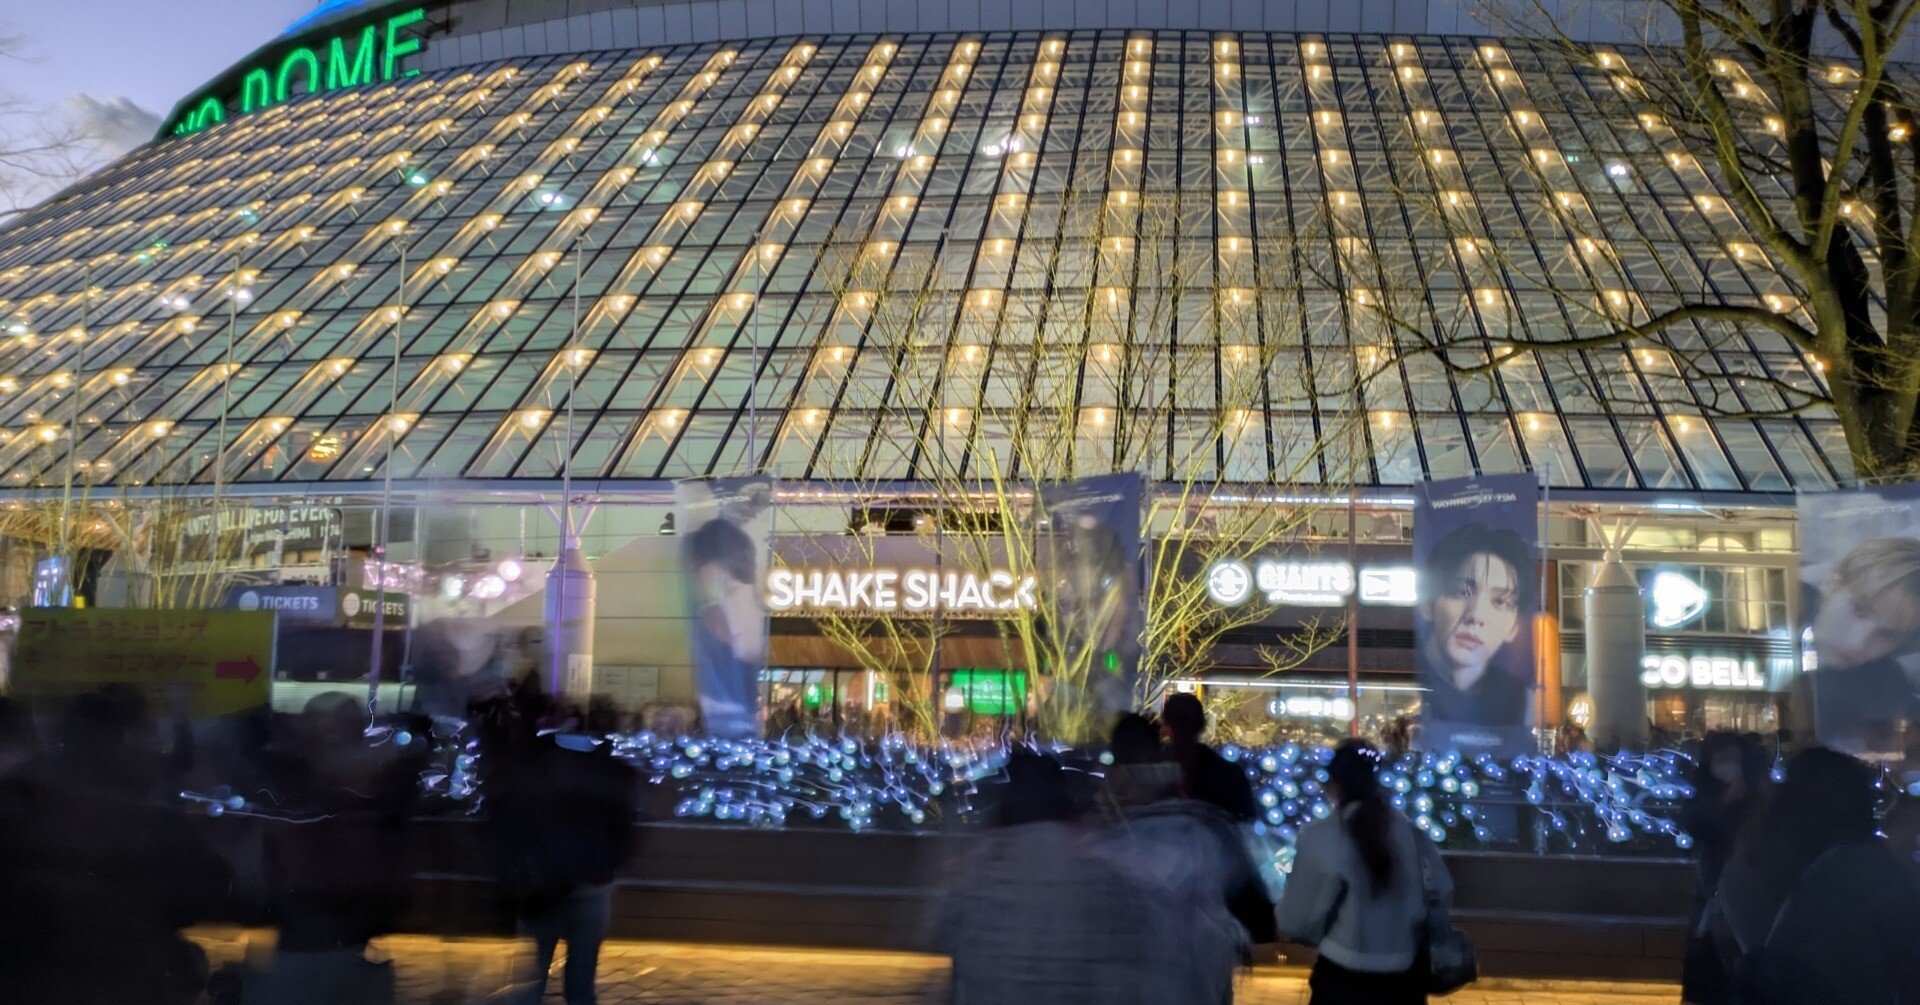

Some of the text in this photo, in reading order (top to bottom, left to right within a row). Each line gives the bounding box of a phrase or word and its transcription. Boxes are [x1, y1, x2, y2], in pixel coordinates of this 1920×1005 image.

[770, 569, 1036, 609] SHAKE SHACK
[1259, 563, 1351, 591] GIANTS
[262, 596, 319, 611] TICKETS
[362, 600, 404, 616] TICKETS
[1691, 658, 1765, 687] BELL
